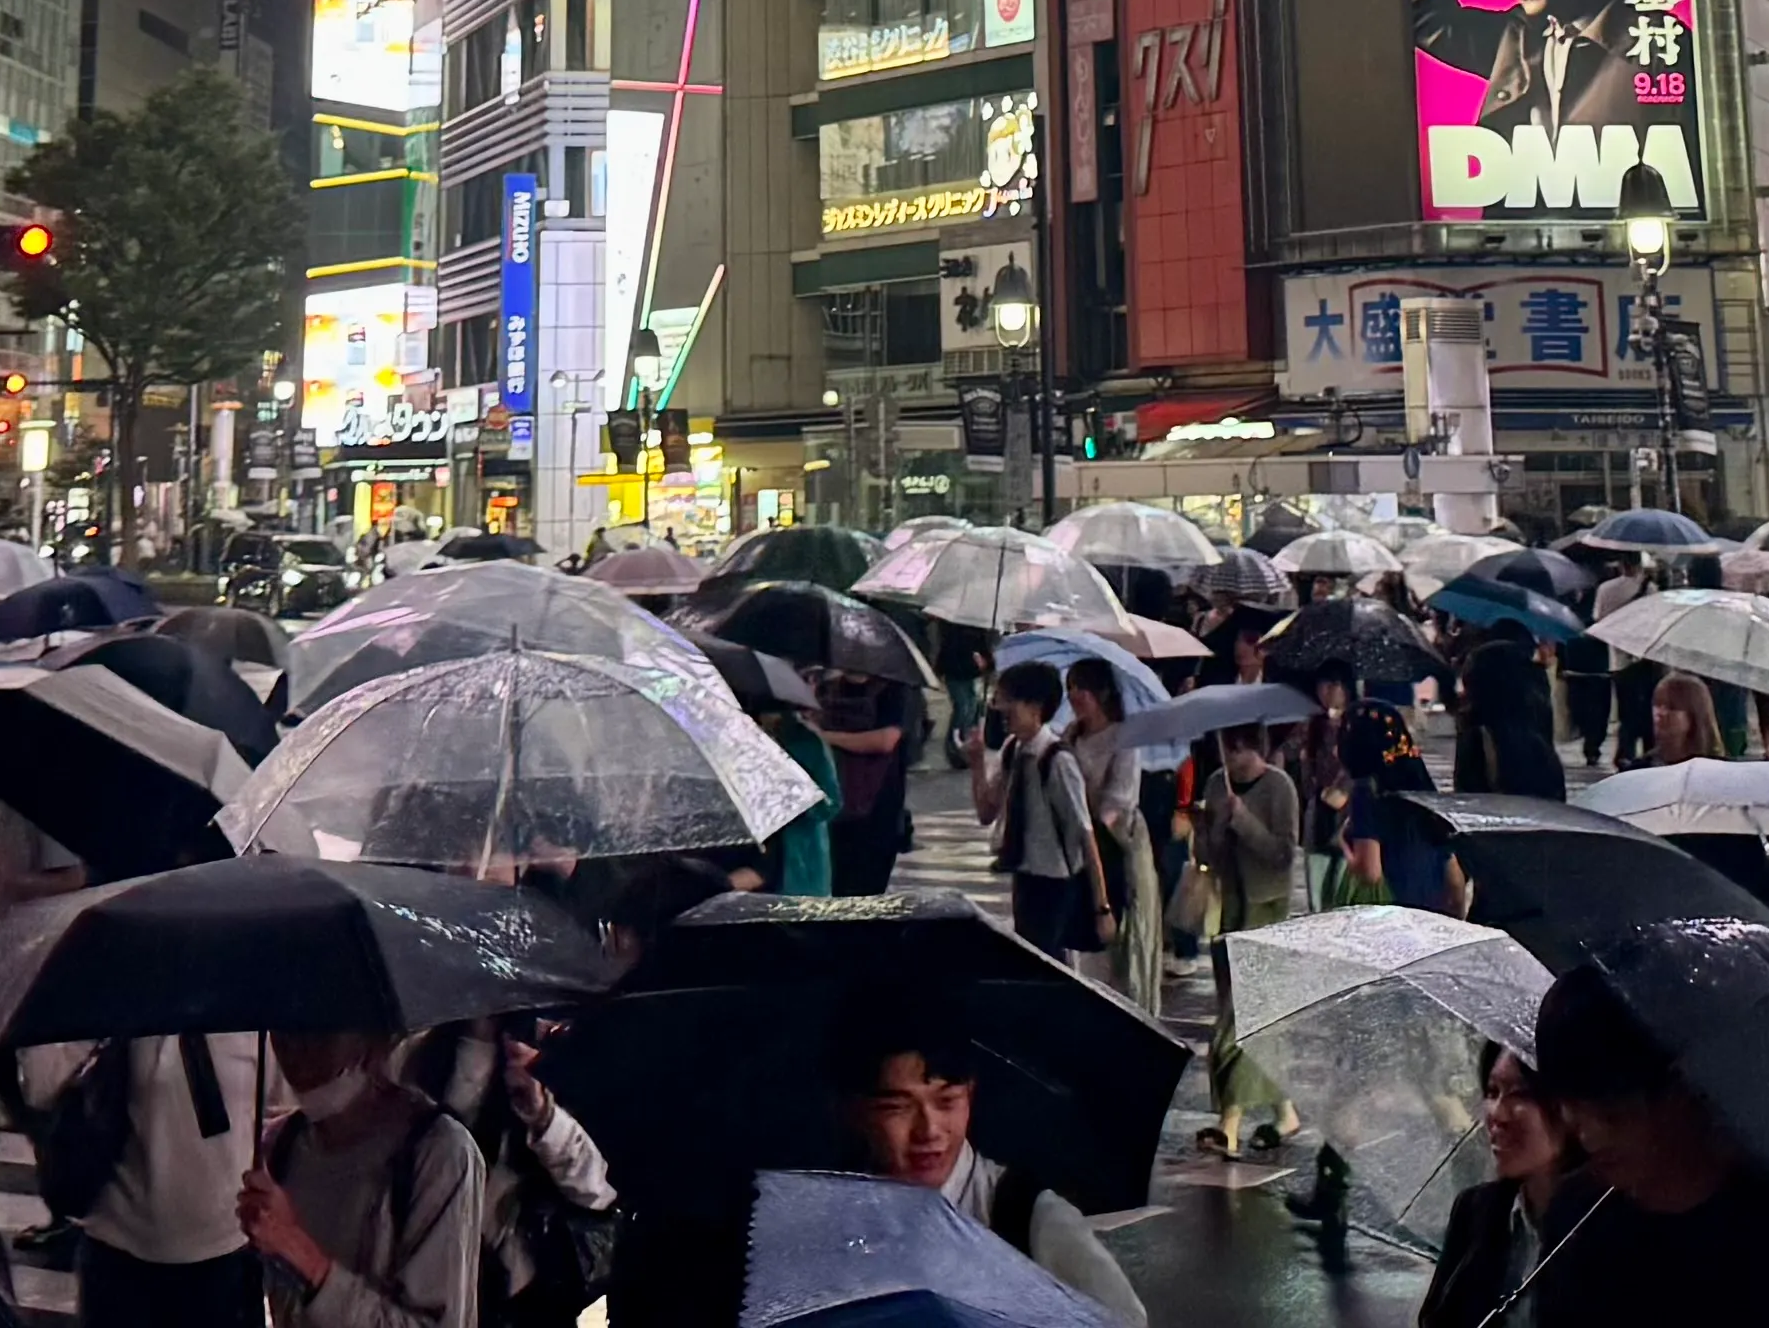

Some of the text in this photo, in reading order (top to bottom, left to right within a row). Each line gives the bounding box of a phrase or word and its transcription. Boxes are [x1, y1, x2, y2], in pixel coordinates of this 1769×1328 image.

[1633, 71, 1686, 96] 9.18
[511, 190, 530, 265] MIZUHO
[1303, 287, 1682, 365] 大盛書店
[1571, 414, 1645, 426] TAISEIDO
